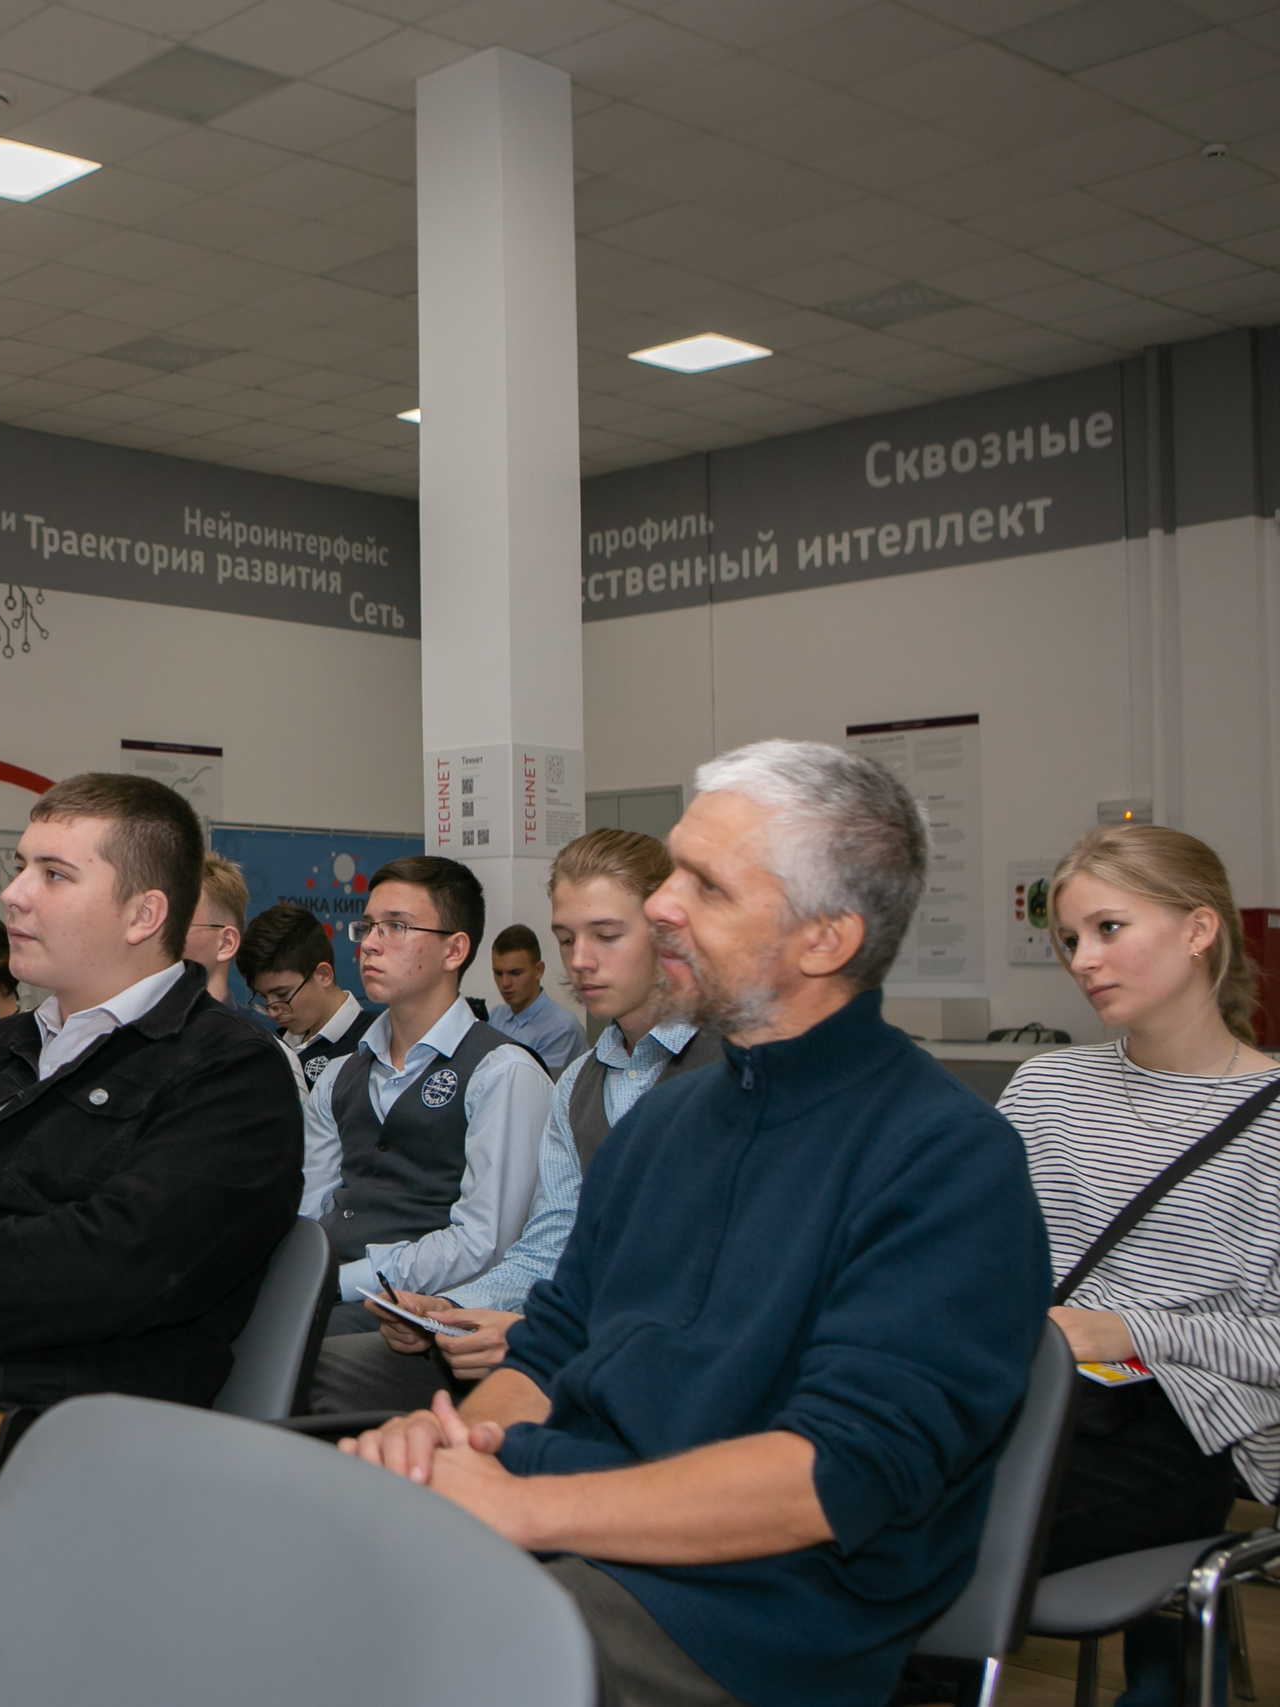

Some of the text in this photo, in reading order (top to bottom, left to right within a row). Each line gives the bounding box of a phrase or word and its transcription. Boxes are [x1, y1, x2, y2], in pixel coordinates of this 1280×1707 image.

[865, 411, 1113, 488] Сквозные
[23, 514, 342, 595] Траектория развития
[184, 507, 389, 567] Нейроинтерфейс
[589, 513, 714, 559] профиль
[798, 498, 1053, 571] интеллект
[349, 593, 405, 629] Сеть
[437, 758, 451, 847] TECHNET
[524, 753, 537, 845] TECHNET
